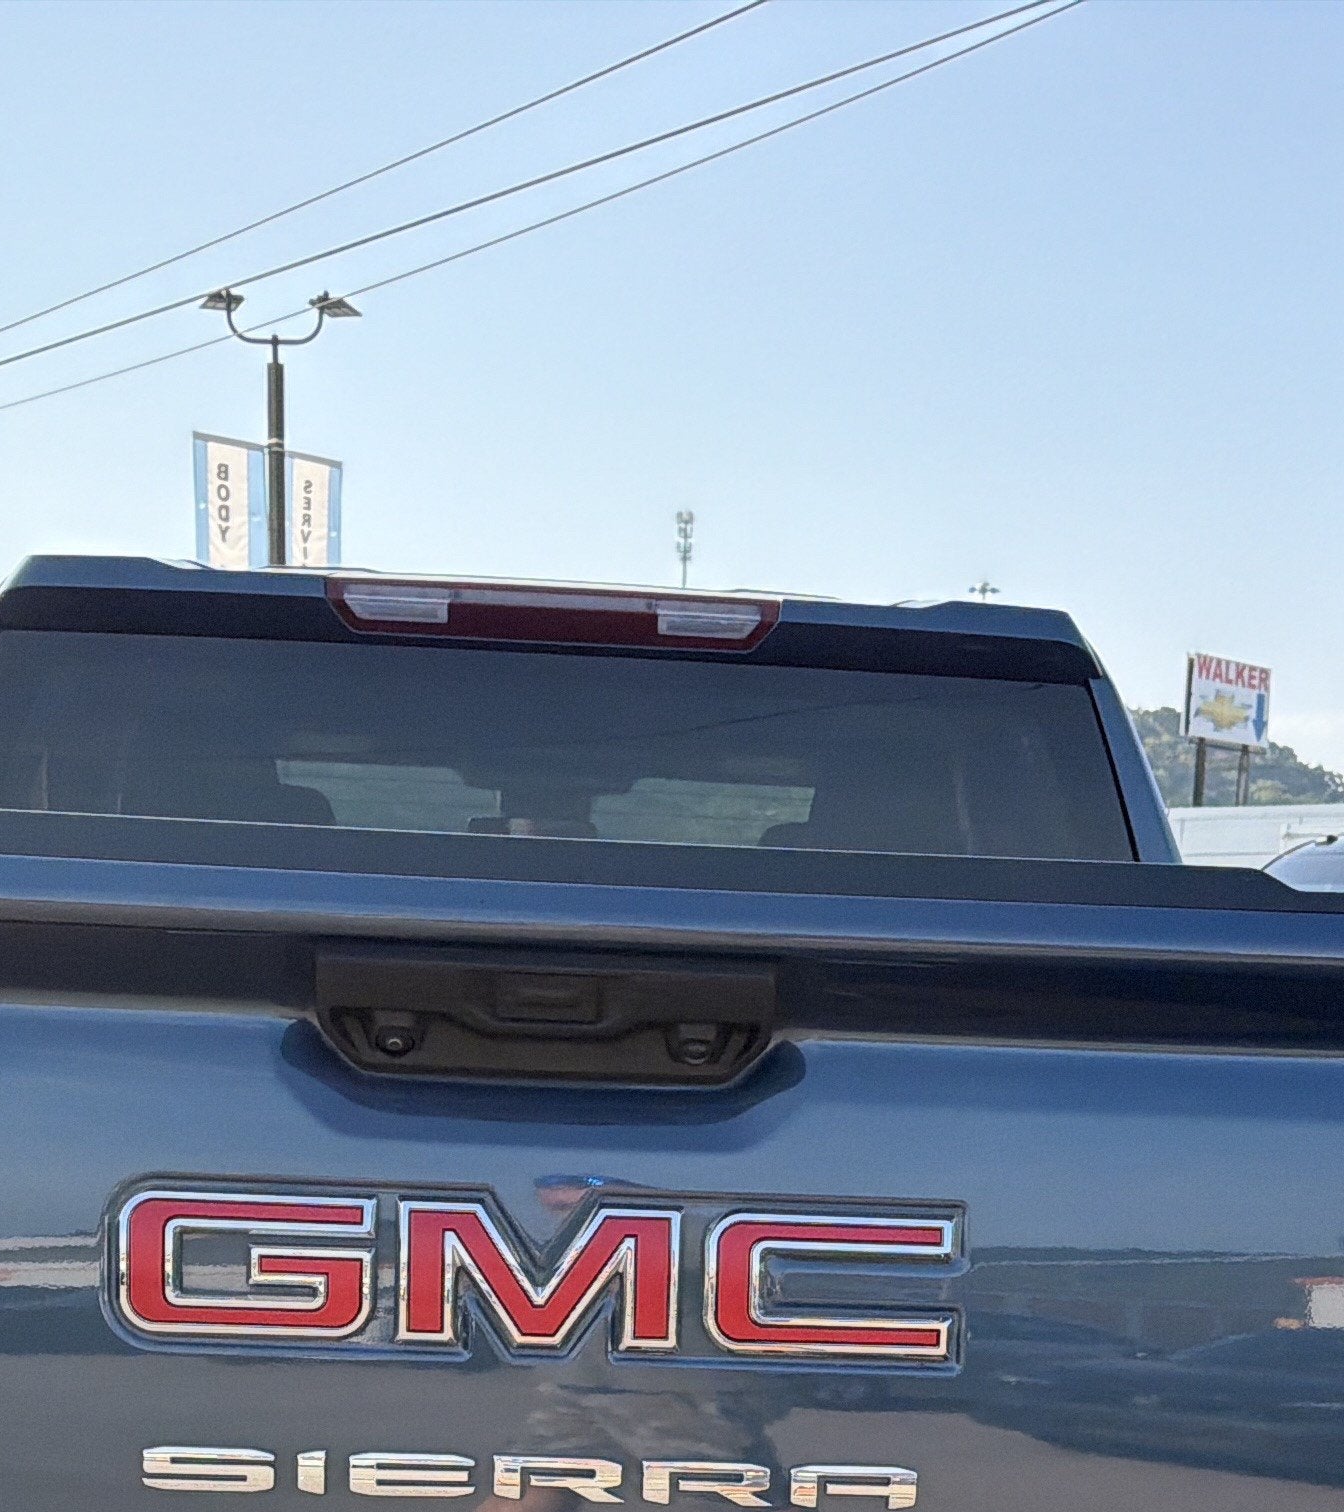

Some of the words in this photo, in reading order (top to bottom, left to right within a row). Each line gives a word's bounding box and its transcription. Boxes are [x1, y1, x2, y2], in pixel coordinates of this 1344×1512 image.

[1196, 653, 1270, 692] WALKER
[117, 1190, 956, 1358] GMC
[141, 1444, 919, 1511] SIERRA
